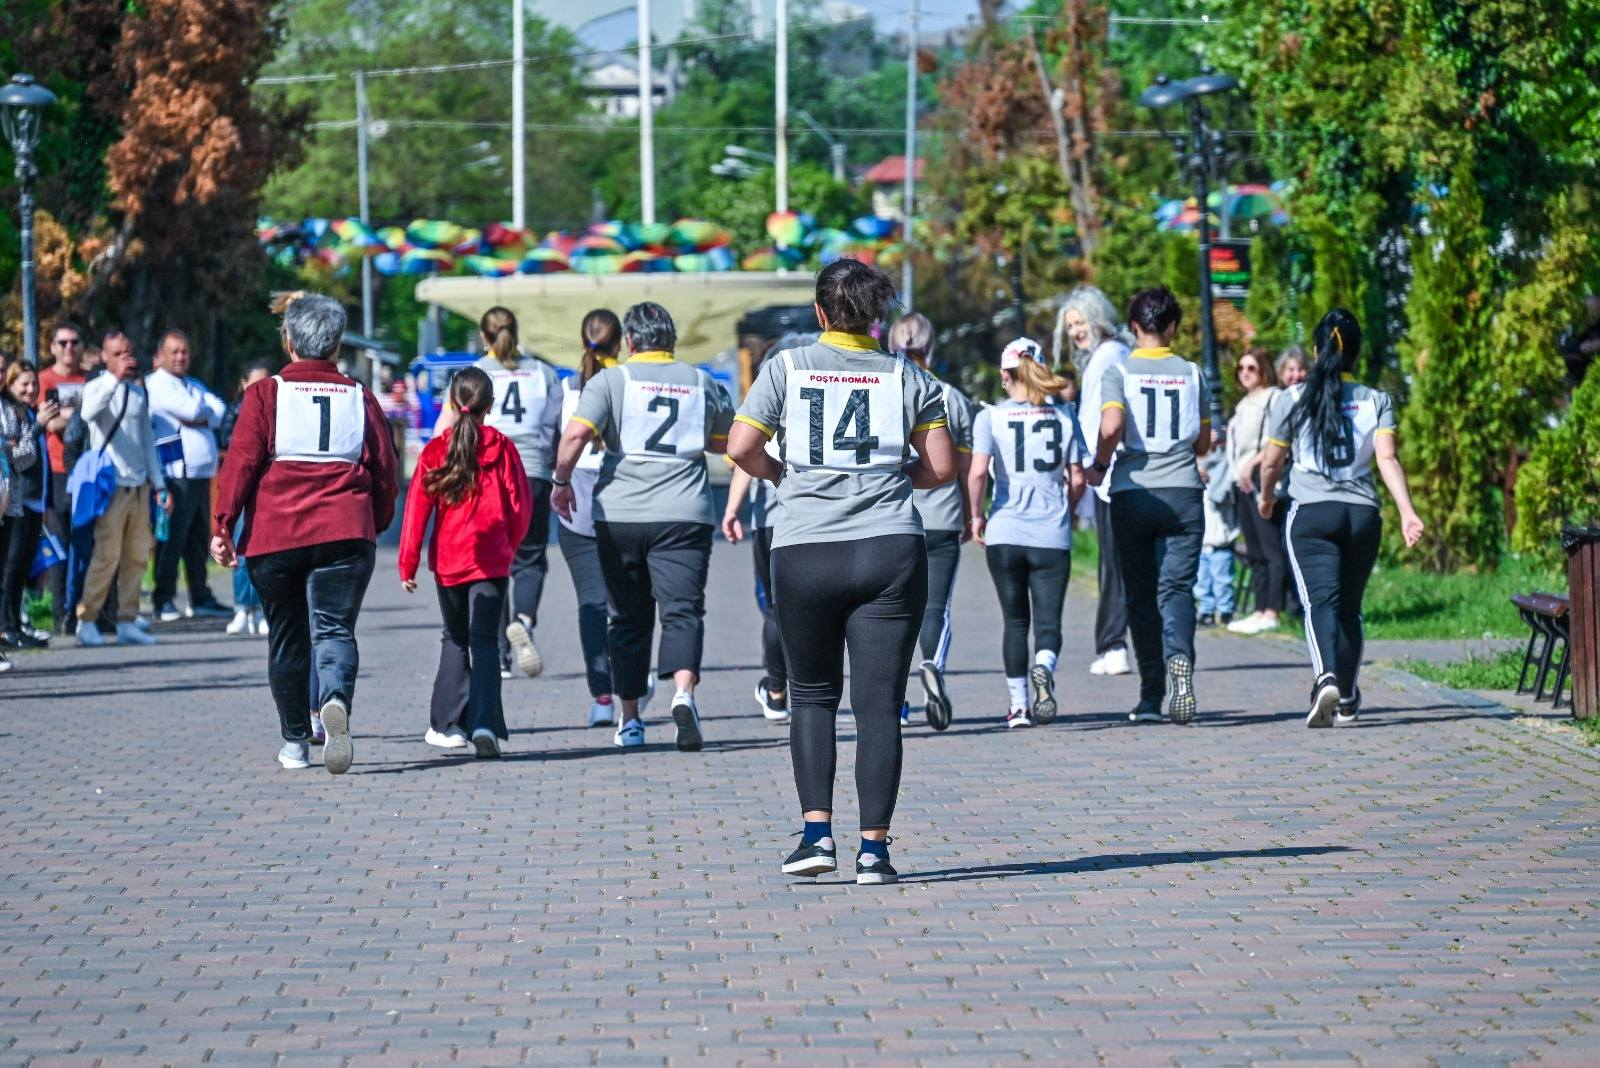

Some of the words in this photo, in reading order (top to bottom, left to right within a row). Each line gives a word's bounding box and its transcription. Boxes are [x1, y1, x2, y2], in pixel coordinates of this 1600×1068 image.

[312, 396, 330, 451] 1
[501, 381, 526, 423] 4
[644, 396, 679, 455] 2
[800, 387, 879, 465] 14
[1140, 387, 1180, 440] 11
[1008, 419, 1062, 473] 13
